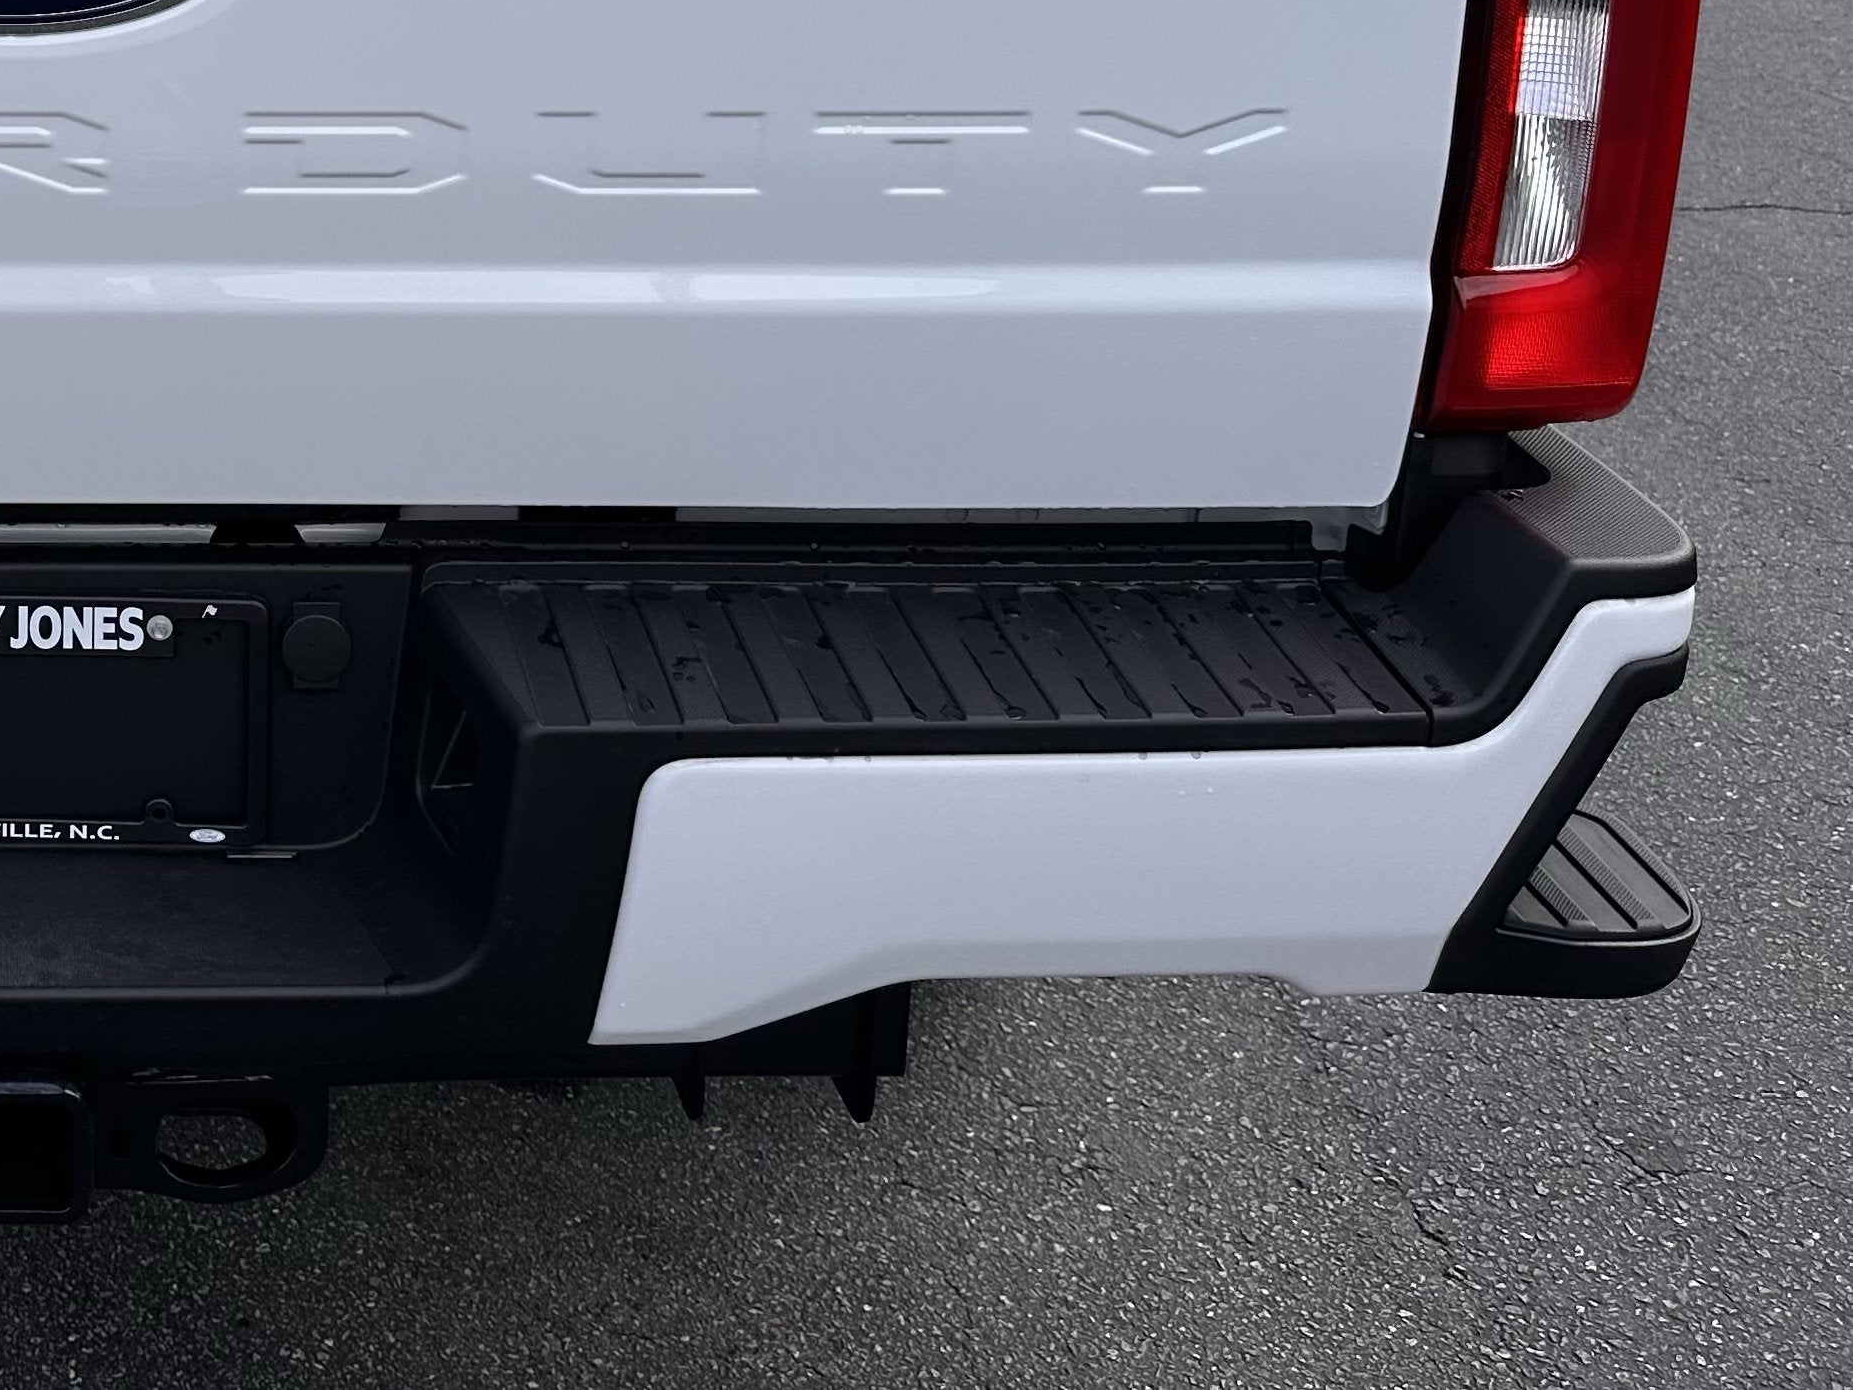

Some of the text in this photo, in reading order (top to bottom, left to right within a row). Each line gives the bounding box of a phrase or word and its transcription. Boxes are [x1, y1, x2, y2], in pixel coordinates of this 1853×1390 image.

[242, 106, 1290, 196] DUTY
[10, 605, 144, 651] JONES
[69, 824, 120, 841] N.C.
